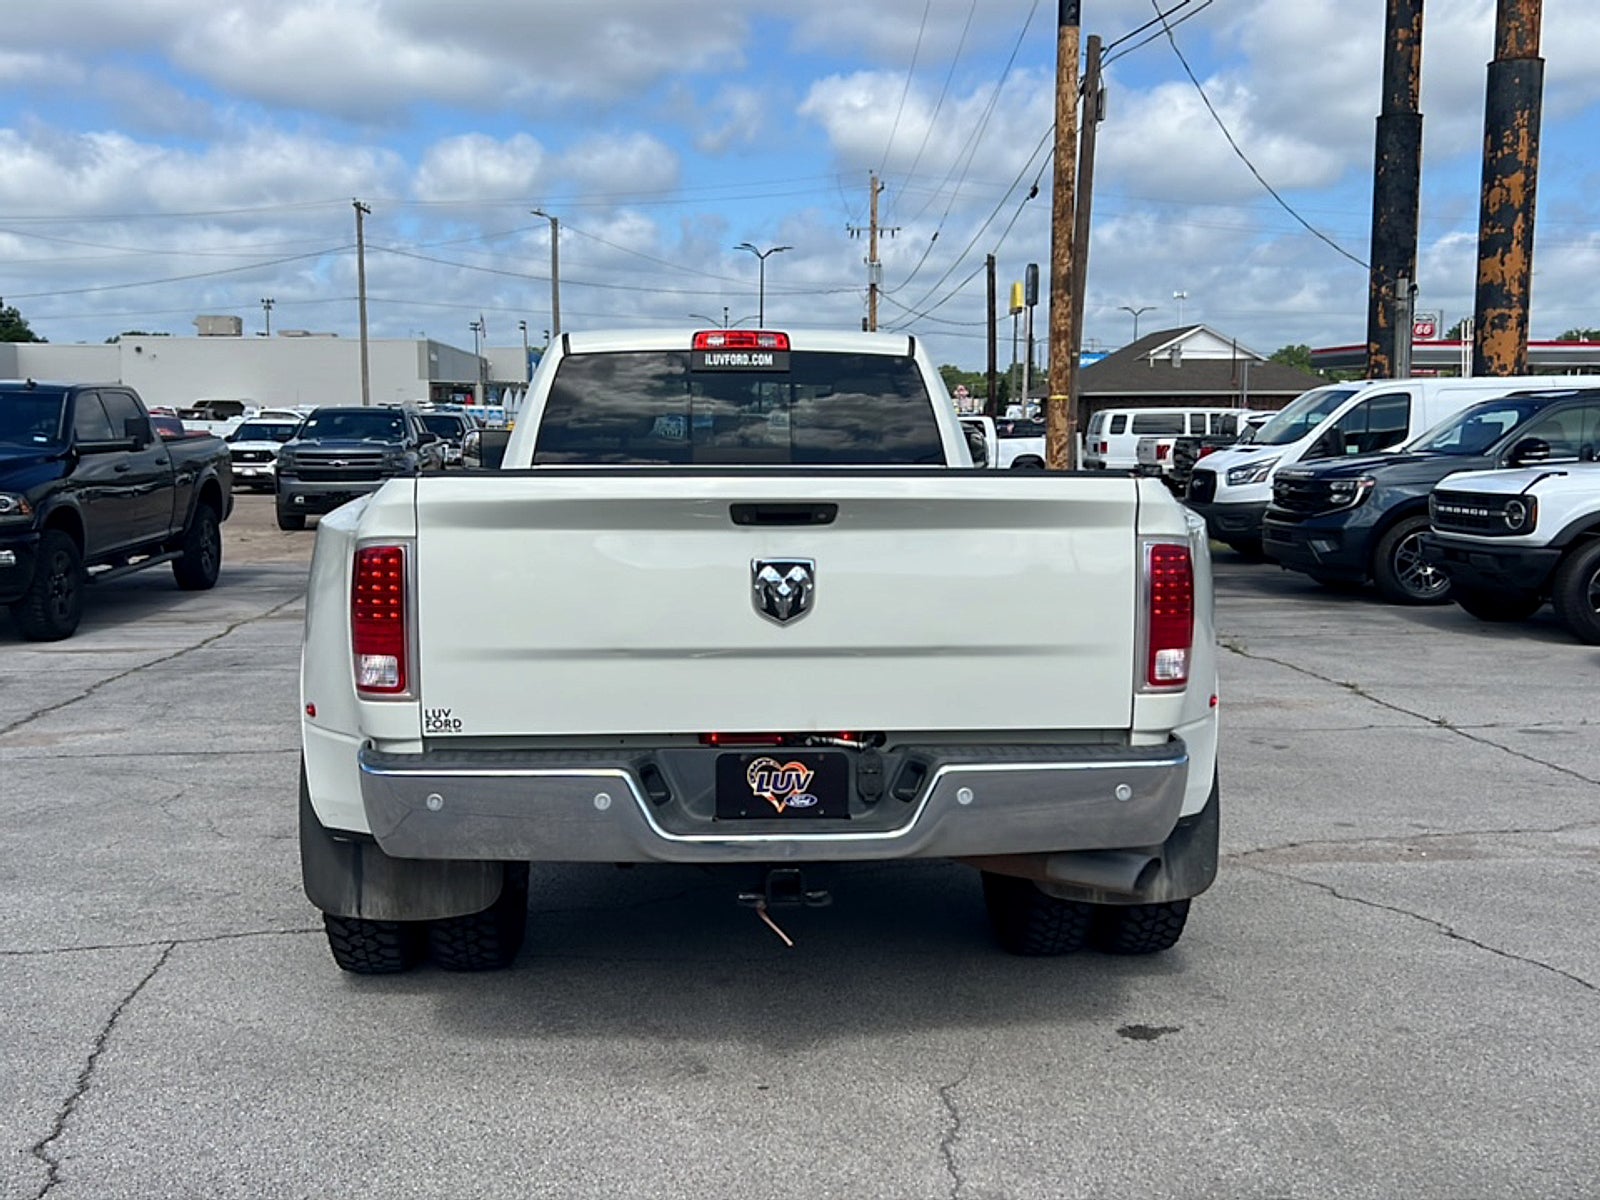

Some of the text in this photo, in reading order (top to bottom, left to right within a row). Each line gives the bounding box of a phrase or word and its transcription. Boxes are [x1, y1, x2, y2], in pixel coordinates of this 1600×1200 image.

[1415, 324, 1431, 335] 66
[704, 353, 773, 365] ILUVFORD.COM
[425, 708, 451, 720] LUV
[425, 719, 462, 730] FORD
[755, 771, 814, 794] LUV
